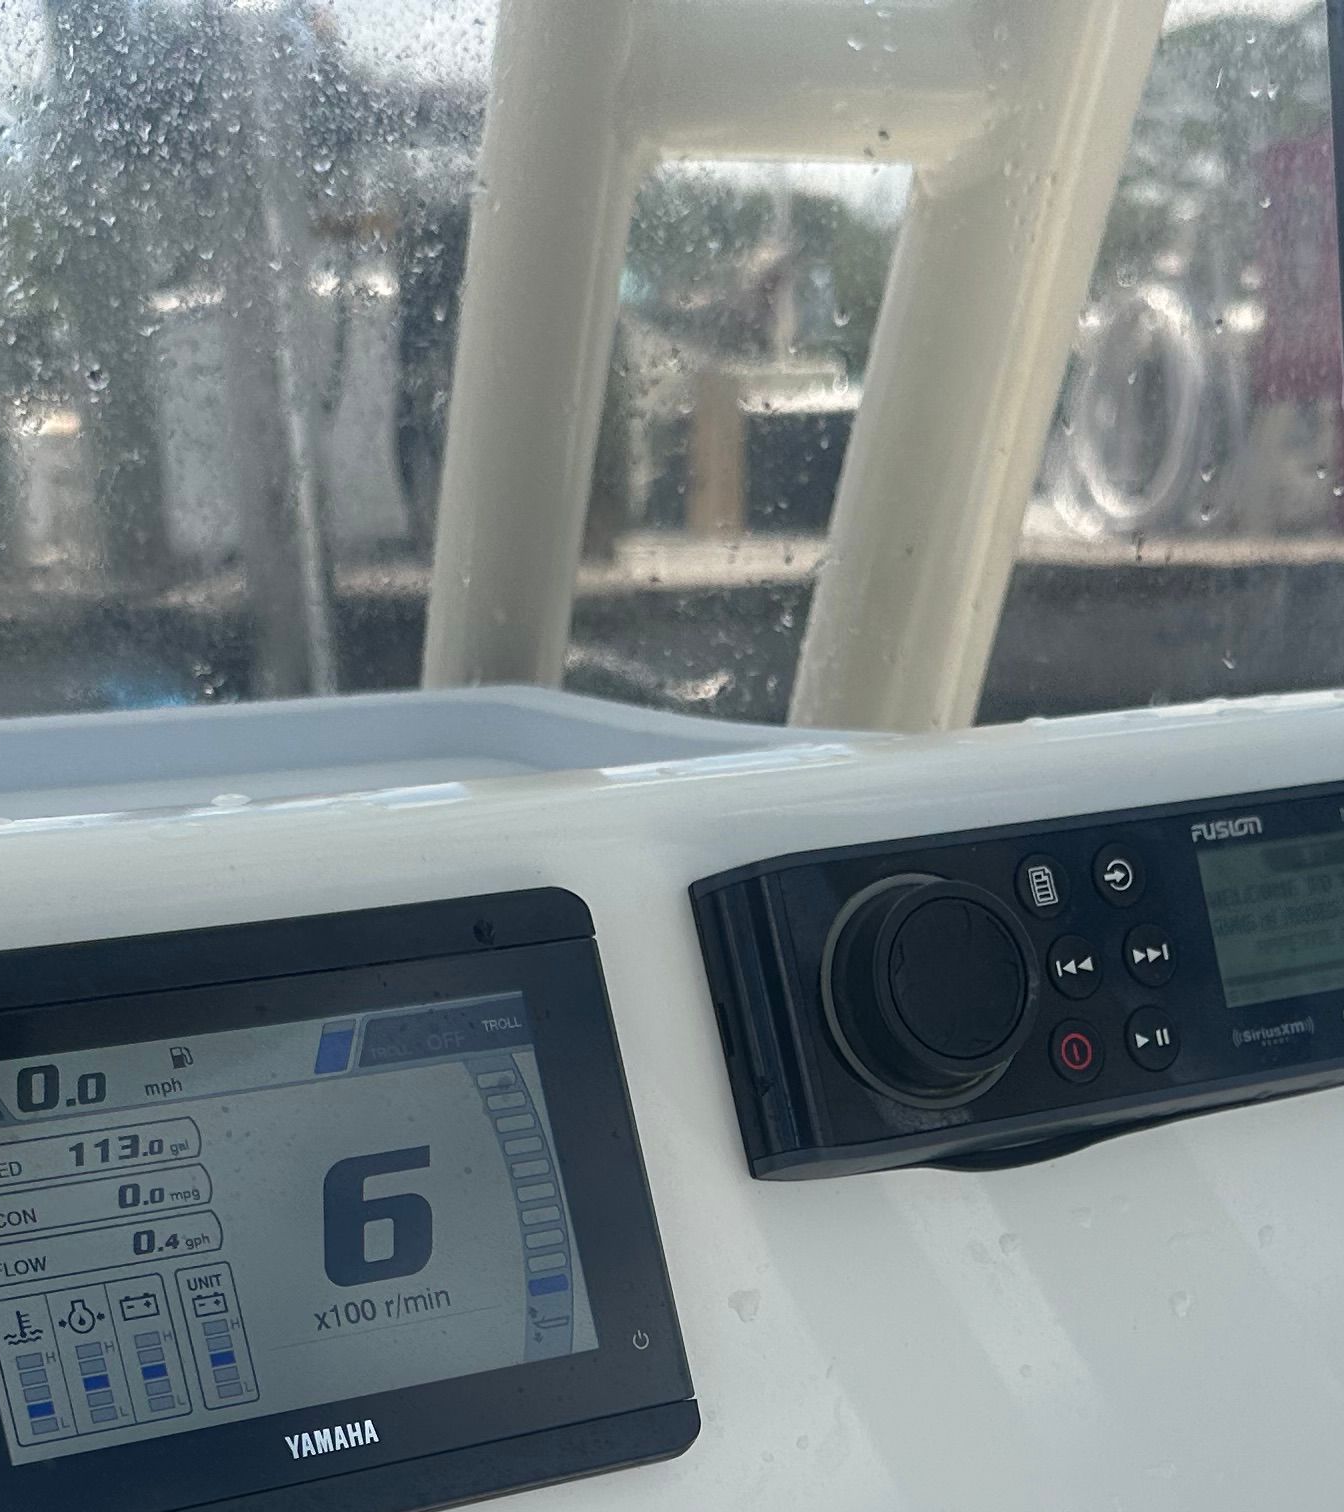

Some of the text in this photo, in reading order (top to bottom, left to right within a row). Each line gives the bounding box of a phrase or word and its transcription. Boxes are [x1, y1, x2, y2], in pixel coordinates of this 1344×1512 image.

[1191, 816, 1262, 843] FUSION
[481, 1017, 522, 1032] TROLL
[426, 1032, 465, 1051] OFF
[17, 1064, 182, 1113] 0.0 mph
[68, 1134, 164, 1167] 113.0
[170, 1139, 189, 1156] gal
[118, 1183, 164, 1209] 0.0
[170, 1188, 201, 1202] mpg
[323, 1145, 433, 1287] 6
[133, 1229, 180, 1255] 0.4
[185, 1233, 210, 1249] gph
[186, 1274, 222, 1291] UNIT
[314, 1288, 451, 1331] x100 r/min
[46, 1351, 56, 1364] H
[284, 1419, 380, 1459] YAMAHA
